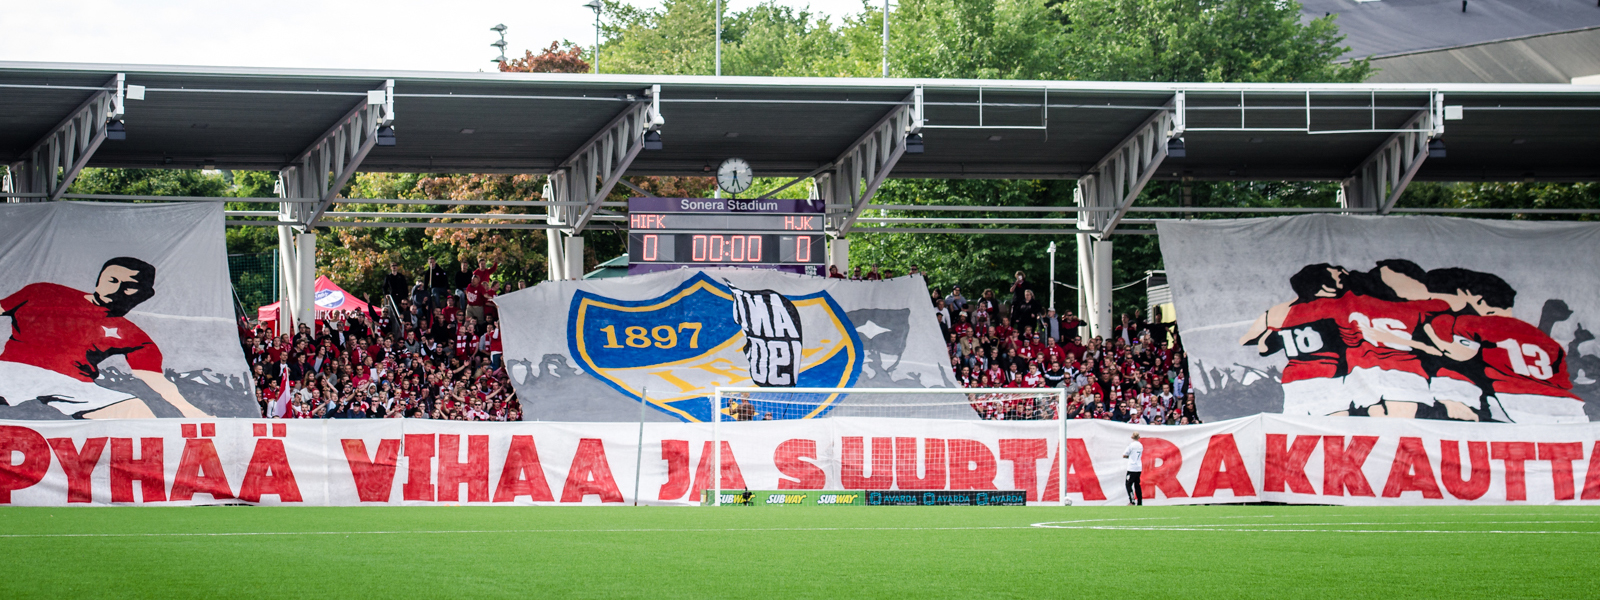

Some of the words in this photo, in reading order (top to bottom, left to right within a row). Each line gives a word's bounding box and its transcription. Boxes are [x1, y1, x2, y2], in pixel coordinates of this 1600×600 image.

[680, 199, 724, 211] Sonera
[727, 199, 778, 211] Stadium
[630, 214, 666, 229] HIFK
[784, 215, 814, 231] HJK
[643, 234, 658, 262] 0
[692, 234, 763, 262] 00:00
[796, 235, 811, 263] 0
[600, 321, 703, 350] 1897
[1277, 326, 1324, 357] 18
[1496, 338, 1553, 380] 13
[0, 422, 303, 505] PYHÄÄ
[341, 433, 625, 504] VIHAA
[657, 438, 747, 503] JA
[773, 435, 1108, 502] SUURTA
[766, 494, 807, 505] SUBWAY
[817, 494, 858, 505] SUBWAY
[883, 494, 918, 503] AVARDA
[936, 494, 971, 503] AVARDA
[989, 494, 1024, 503] AVARDA
